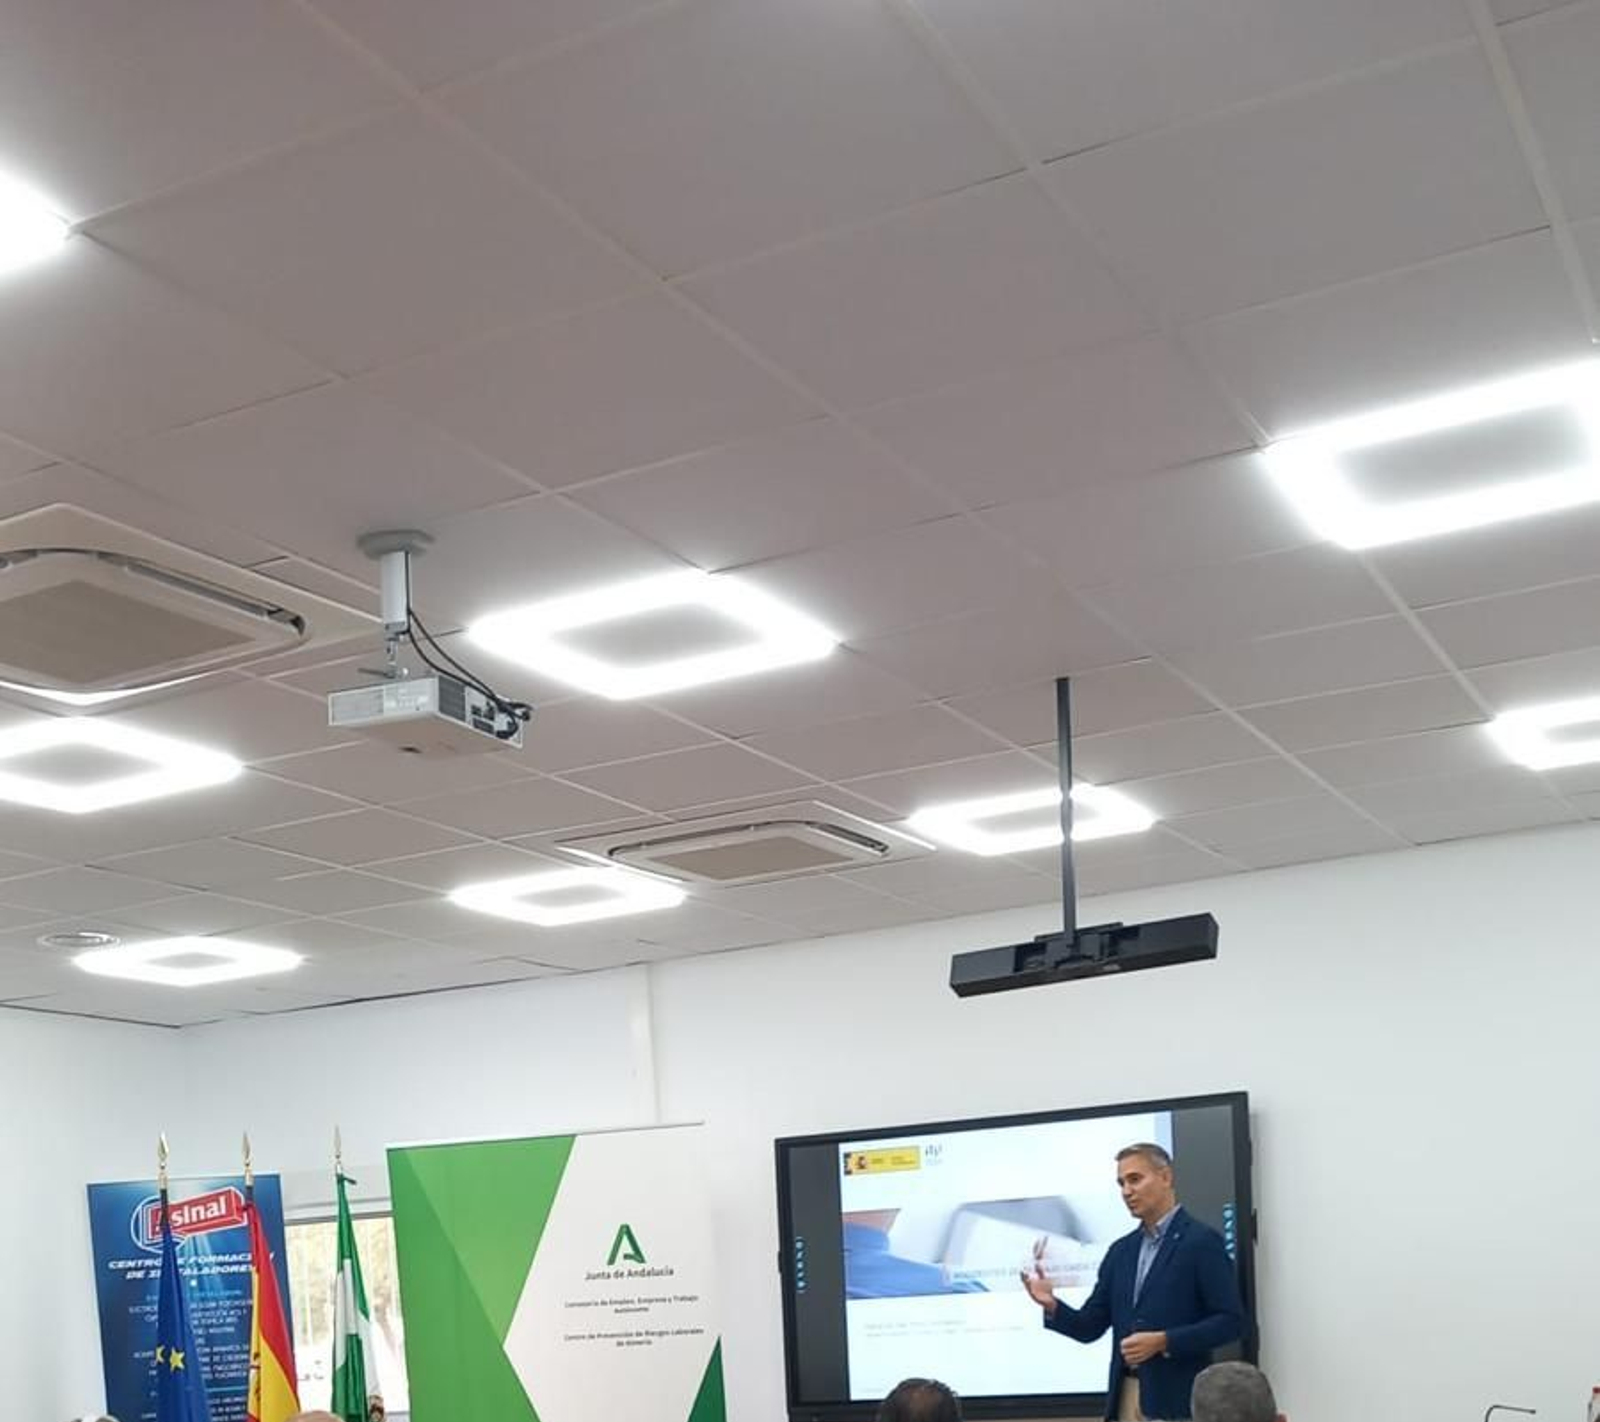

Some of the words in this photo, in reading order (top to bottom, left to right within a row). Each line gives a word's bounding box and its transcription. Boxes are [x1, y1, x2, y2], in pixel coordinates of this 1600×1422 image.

[125, 1269, 145, 1280] DE
[585, 1270, 611, 1280] Junta
[613, 1269, 625, 1279] de
[627, 1265, 674, 1278] Andalucía
